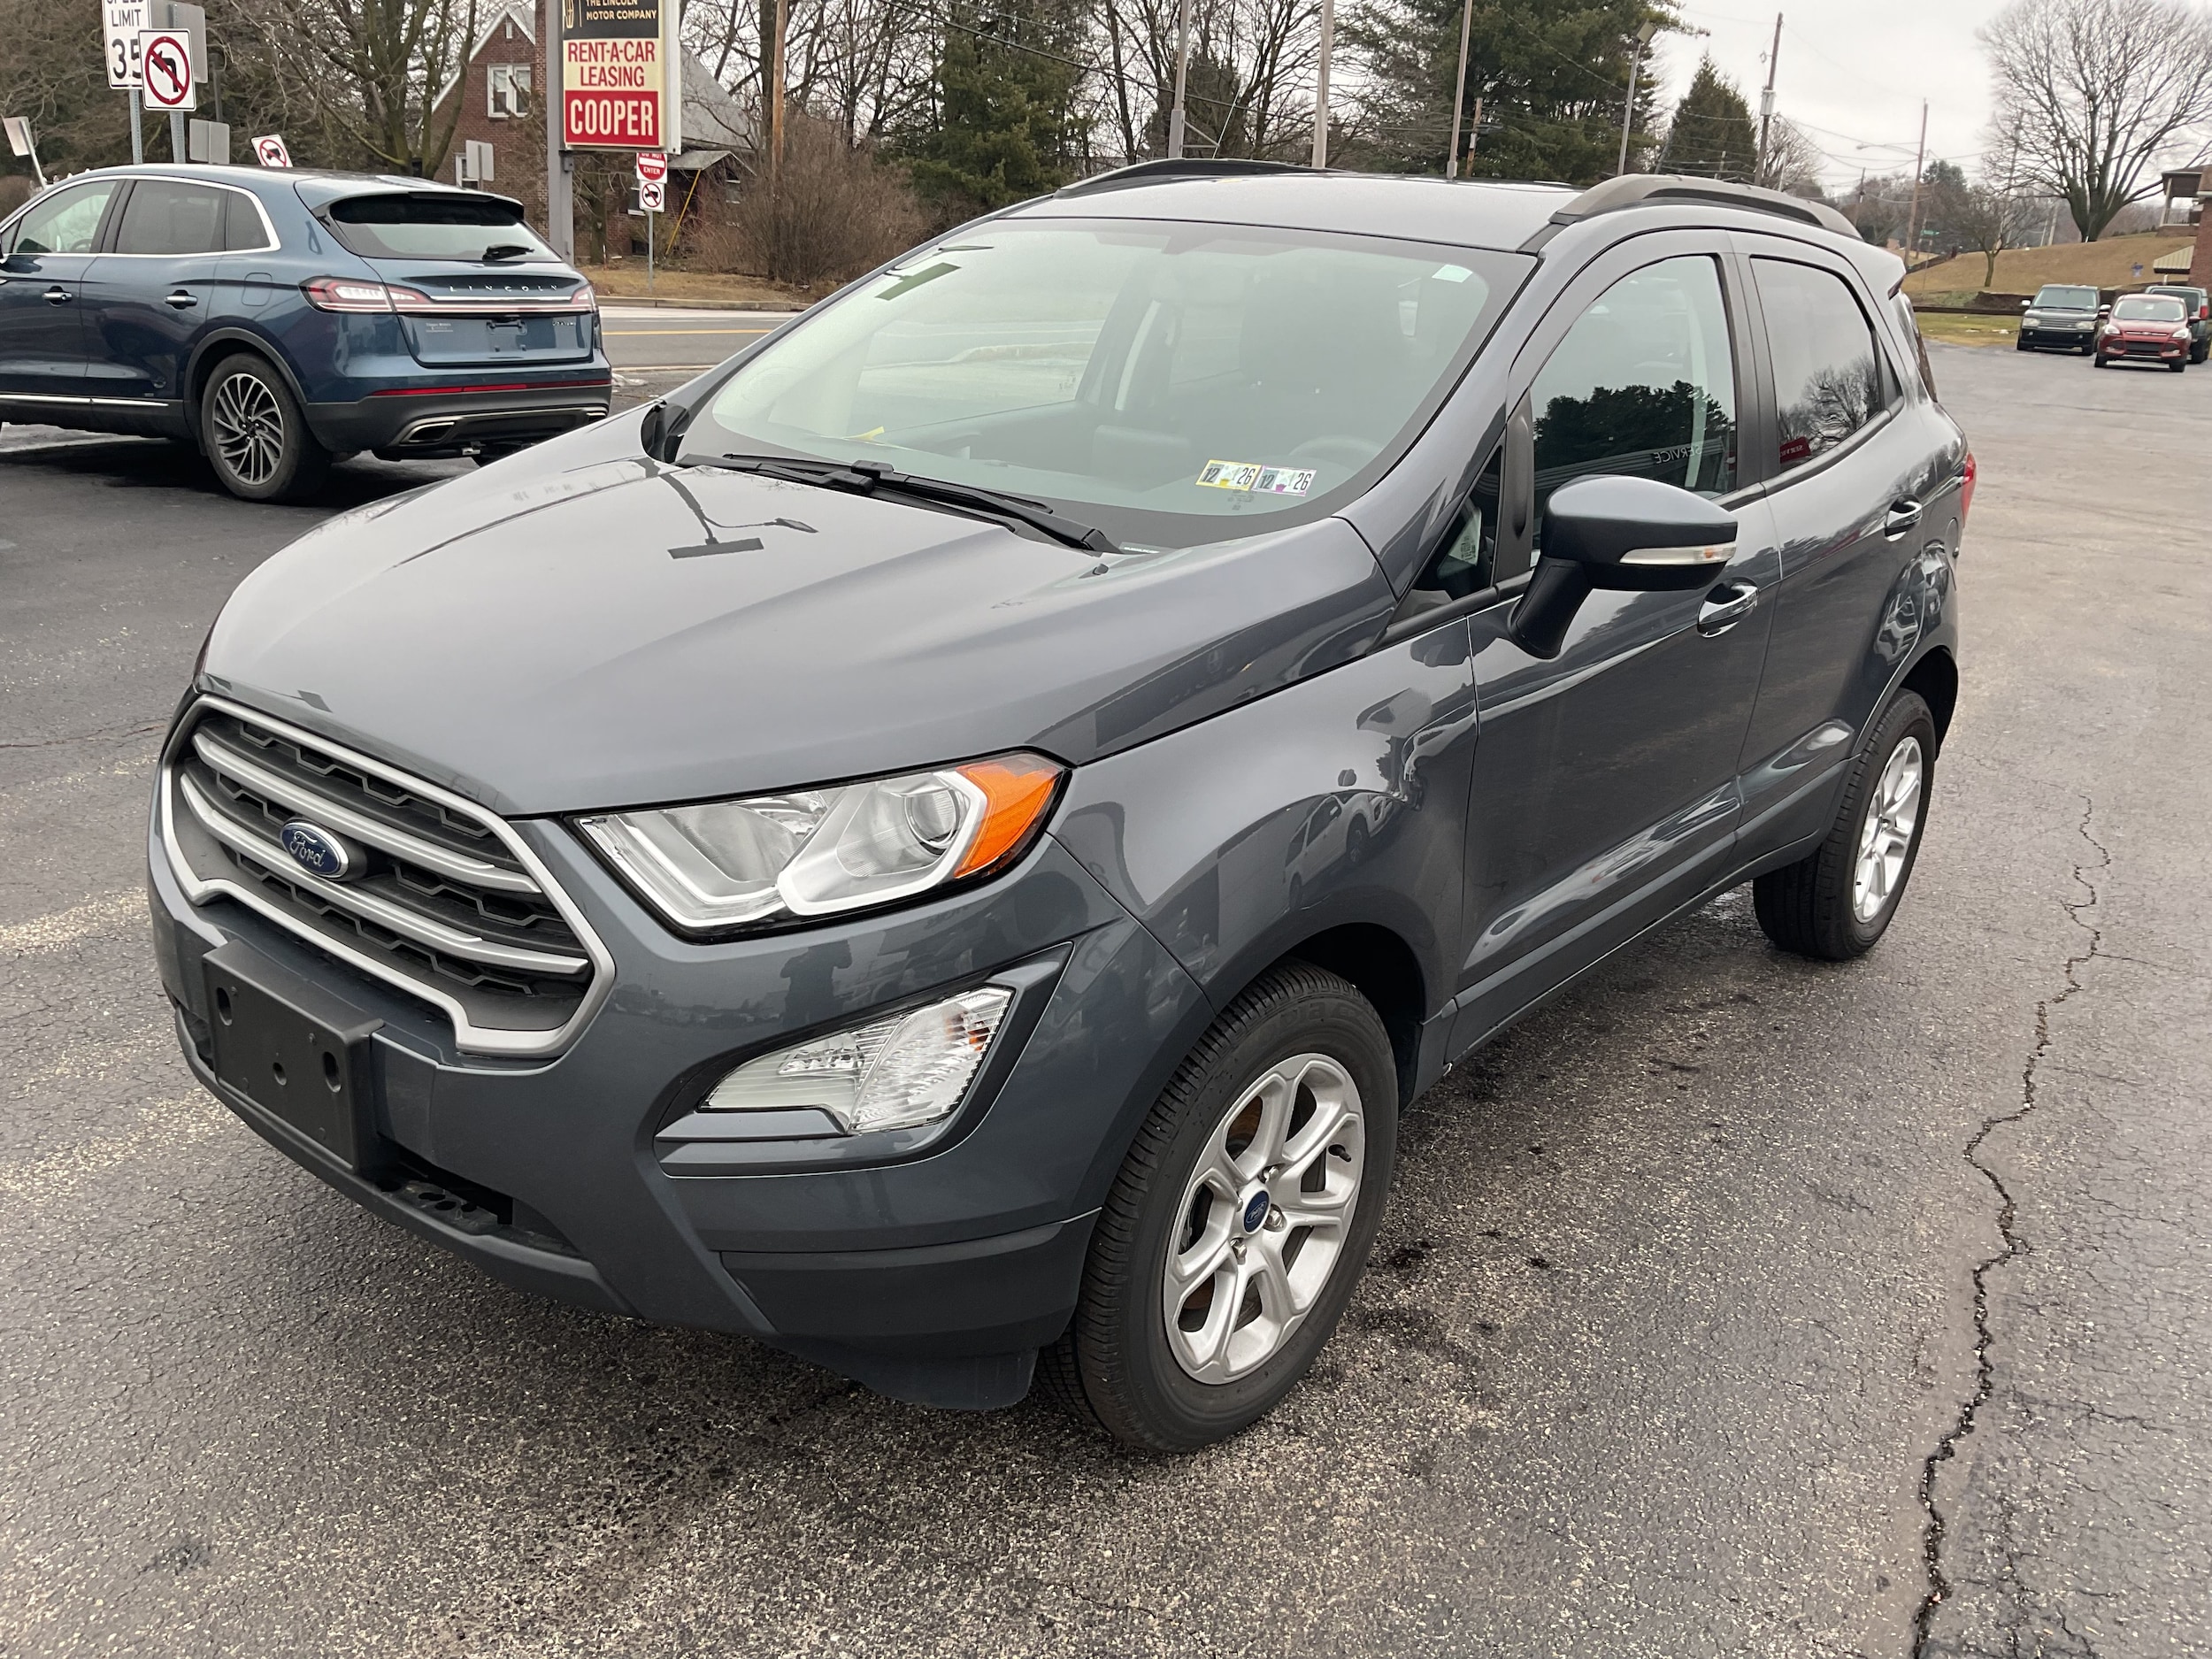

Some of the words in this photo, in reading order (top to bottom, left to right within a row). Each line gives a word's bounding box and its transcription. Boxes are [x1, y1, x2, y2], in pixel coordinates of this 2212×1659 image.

[111, 9, 142, 27] LIMIT
[586, 11, 615, 20] MOTOR
[616, 9, 657, 19] COMPANY
[111, 38, 142, 80] 35
[567, 41, 656, 63] RENT-A-CAR
[580, 65, 645, 88] LEASING
[570, 99, 654, 136] COOPER
[643, 166, 661, 175] ENTER
[449, 284, 558, 293] LINCOLN
[1202, 467, 1221, 483] 12
[1236, 466, 1256, 486] 26
[1258, 473, 1275, 490] 12
[1293, 472, 1312, 491] 26
[289, 830, 326, 867] Ford
